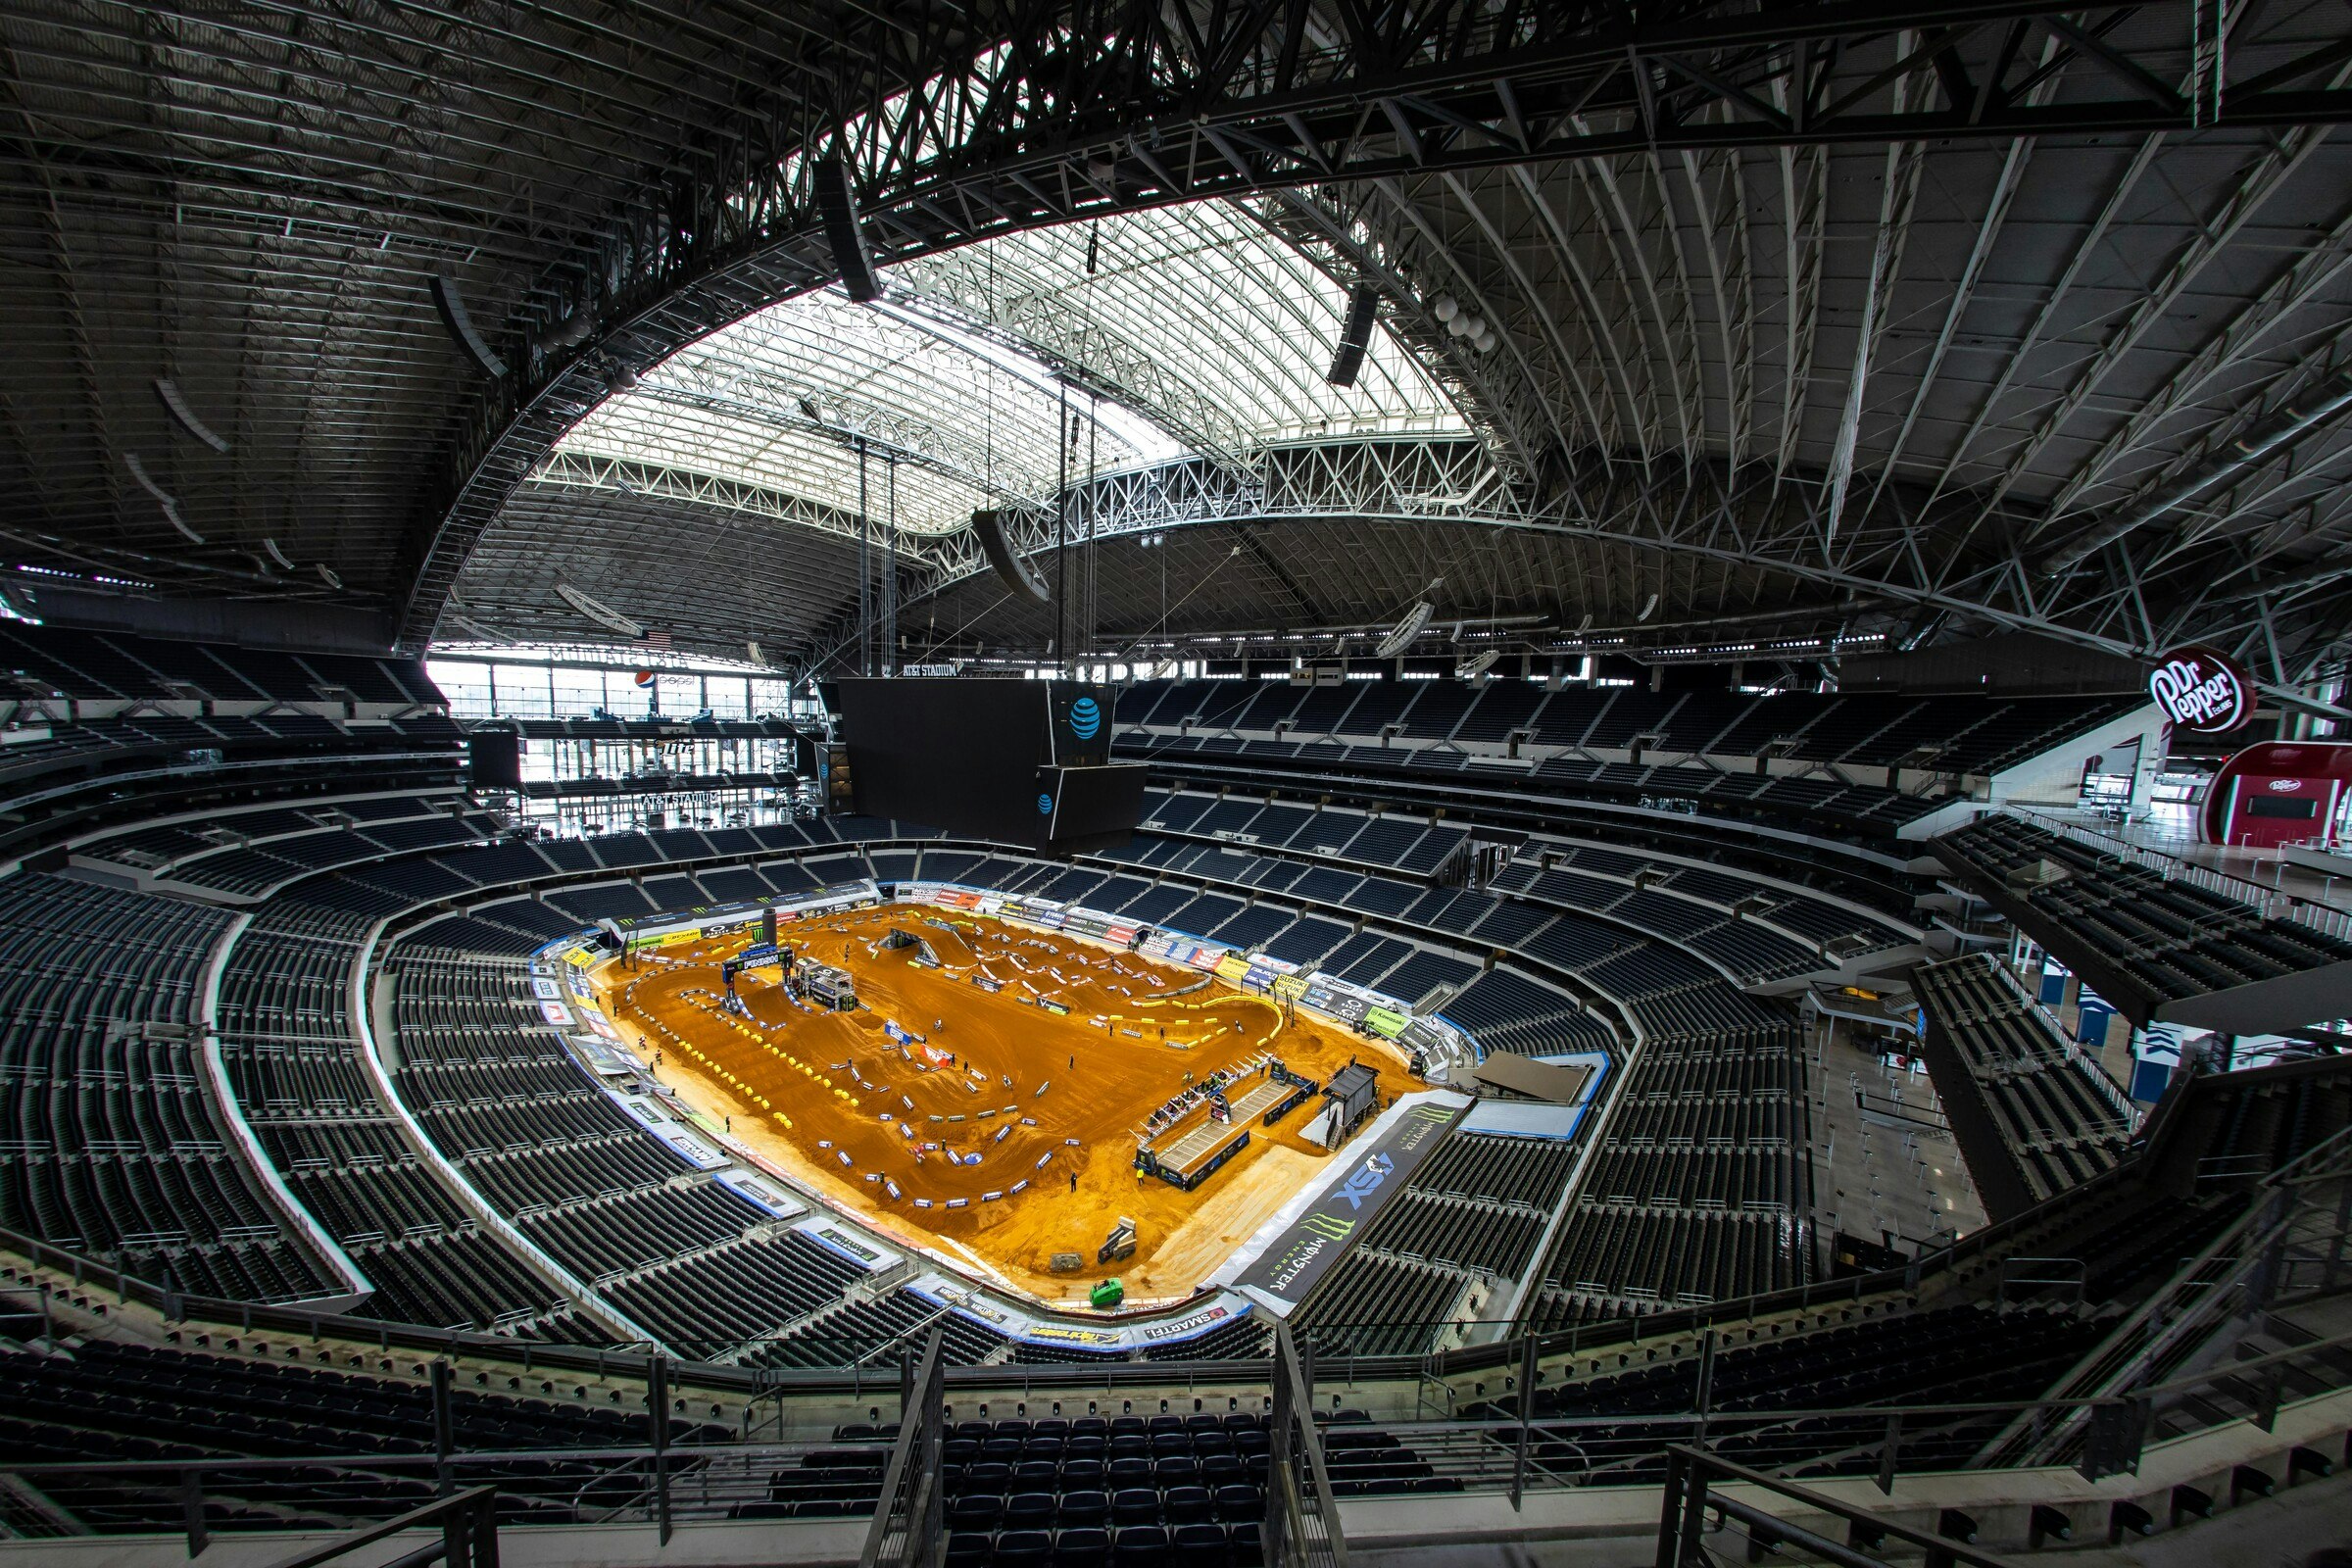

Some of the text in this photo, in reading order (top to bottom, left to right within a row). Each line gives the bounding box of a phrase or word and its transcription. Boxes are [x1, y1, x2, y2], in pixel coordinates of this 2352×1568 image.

[903, 663, 957, 676] AT&T STADIUM
[659, 675, 695, 688] pepsi
[2166, 660, 2200, 694] Dr
[2150, 669, 2230, 724] Pepper
[659, 742, 695, 756] Lite
[642, 792, 718, 806] AT&T STADIUM
[744, 955, 779, 970] FINISH
[1250, 966, 1278, 981] FALKEN
[1276, 982, 1303, 996] SUZUKI
[1279, 975, 1308, 989] SUZUKI
[1341, 1003, 1364, 1013] OAKLEY
[1377, 1012, 1405, 1026] Kawasaki
[1401, 1122, 1436, 1152] MONSTER
[1270, 1240, 1305, 1277] ENERGY
[1270, 1237, 1327, 1291] MONSTER
